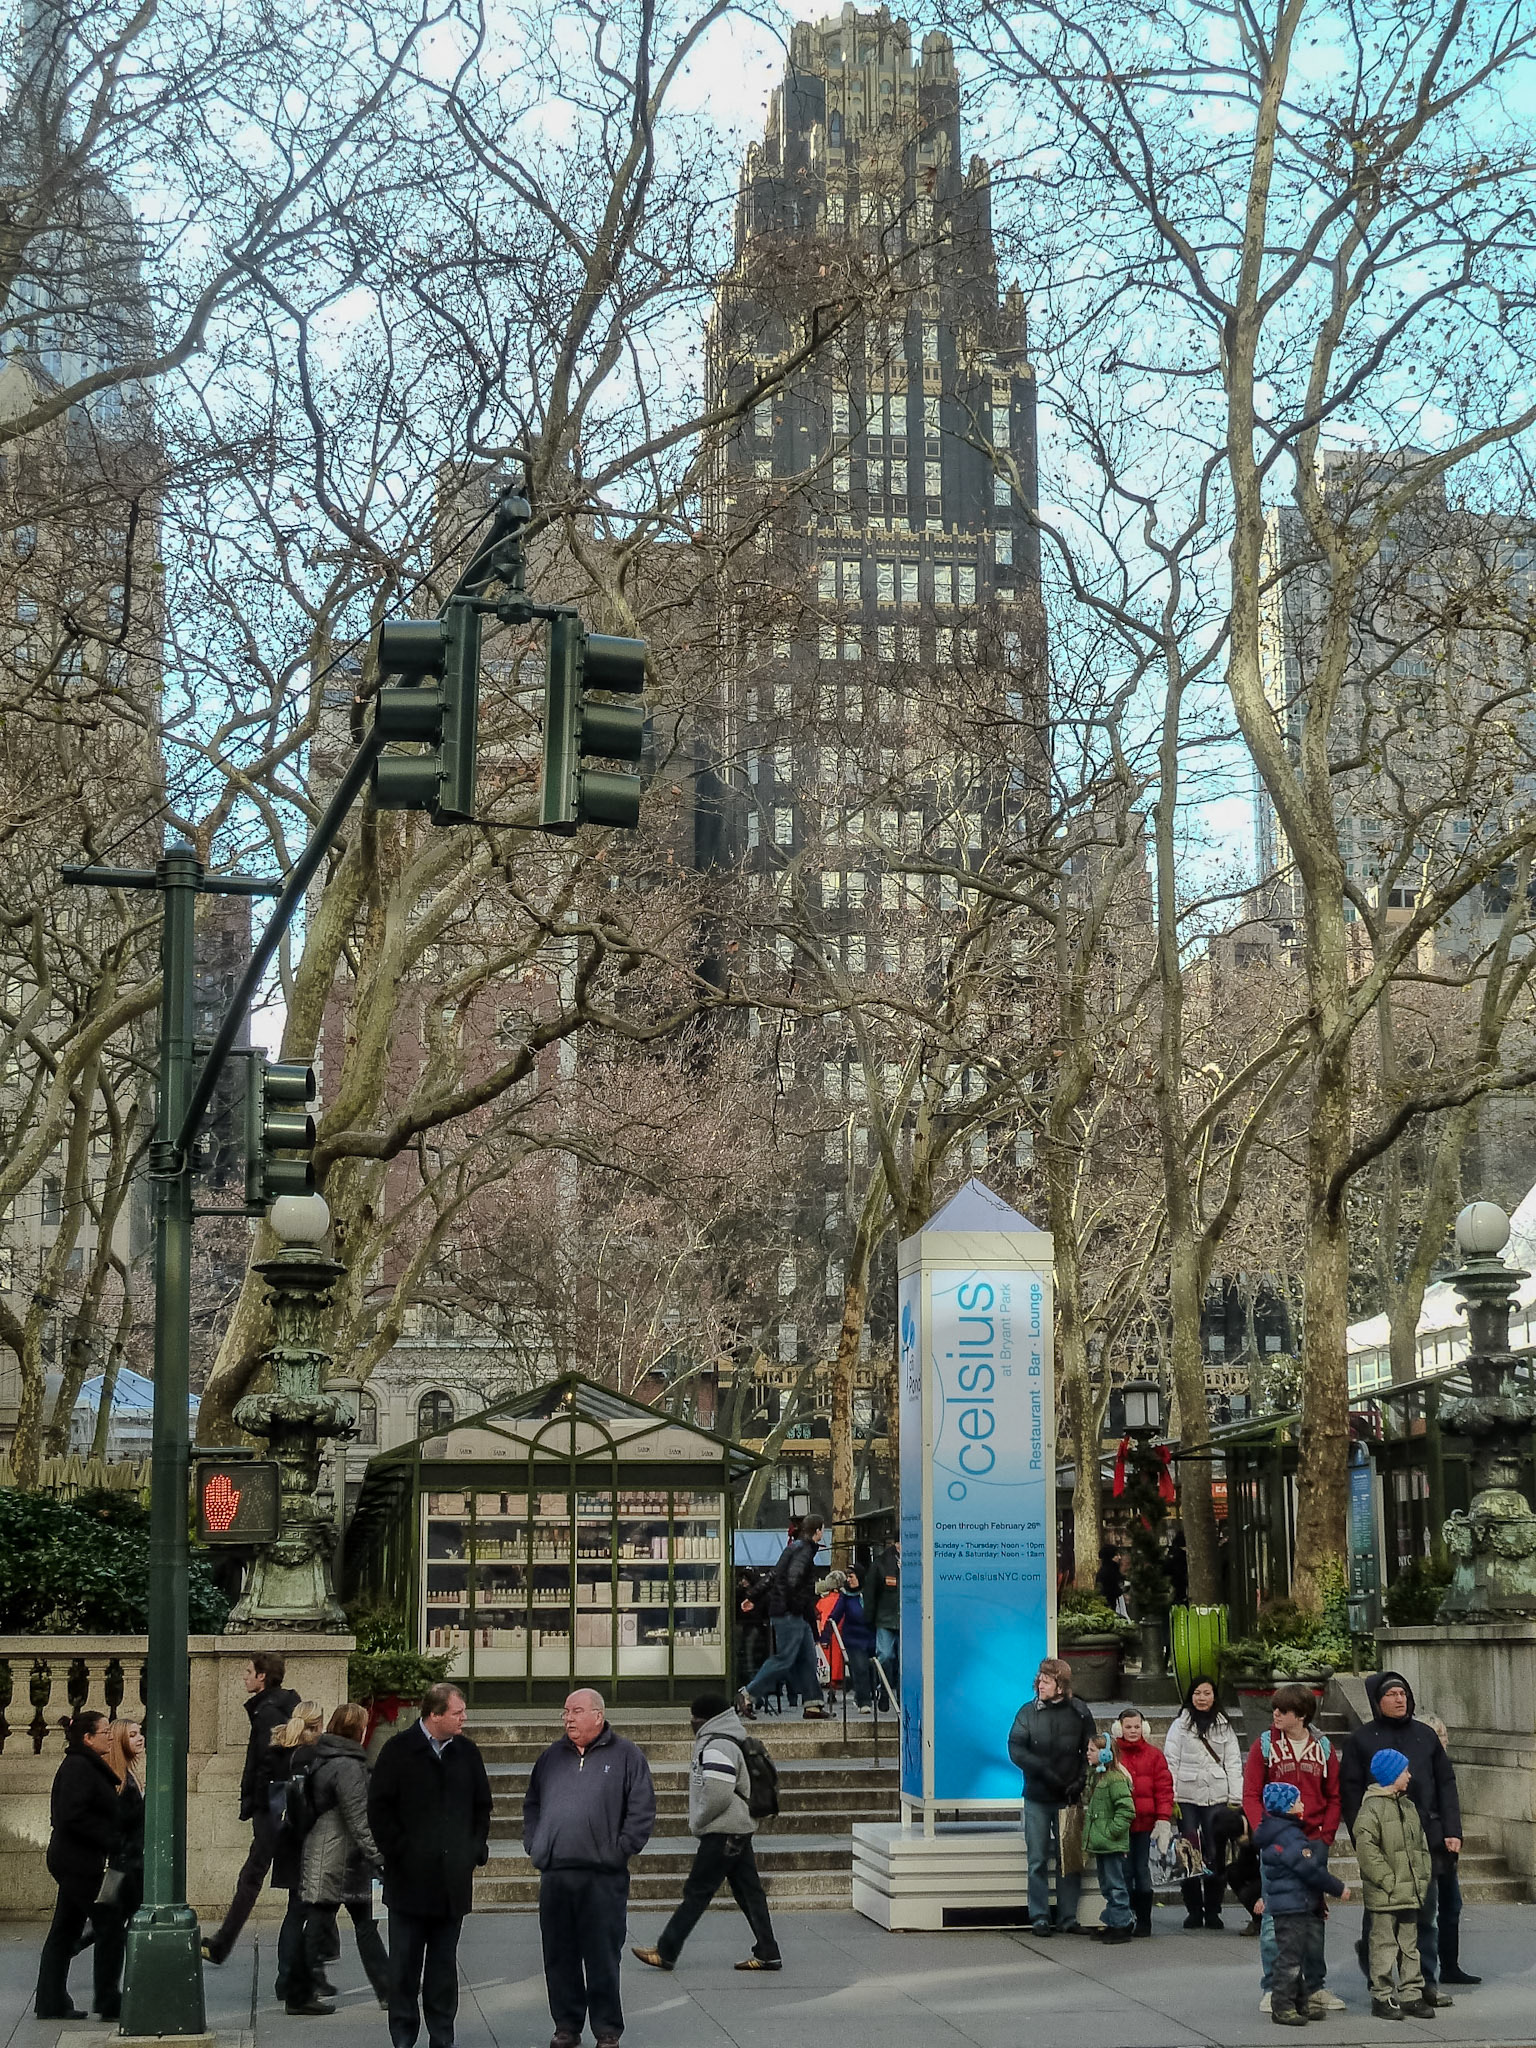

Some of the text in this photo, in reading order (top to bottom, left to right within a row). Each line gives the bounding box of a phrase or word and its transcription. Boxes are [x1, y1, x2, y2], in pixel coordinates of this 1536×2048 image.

[1000, 1283, 1013, 1377] at Bryant Park
[1028, 1283, 1044, 1470] Restaurant Bar Lounge
[934, 1542, 960, 1550] Sunday
[1026, 1542, 1045, 1550] 10pm
[935, 1522, 957, 1531] Open
[958, 1522, 989, 1531] through
[991, 1522, 1026, 1531] February
